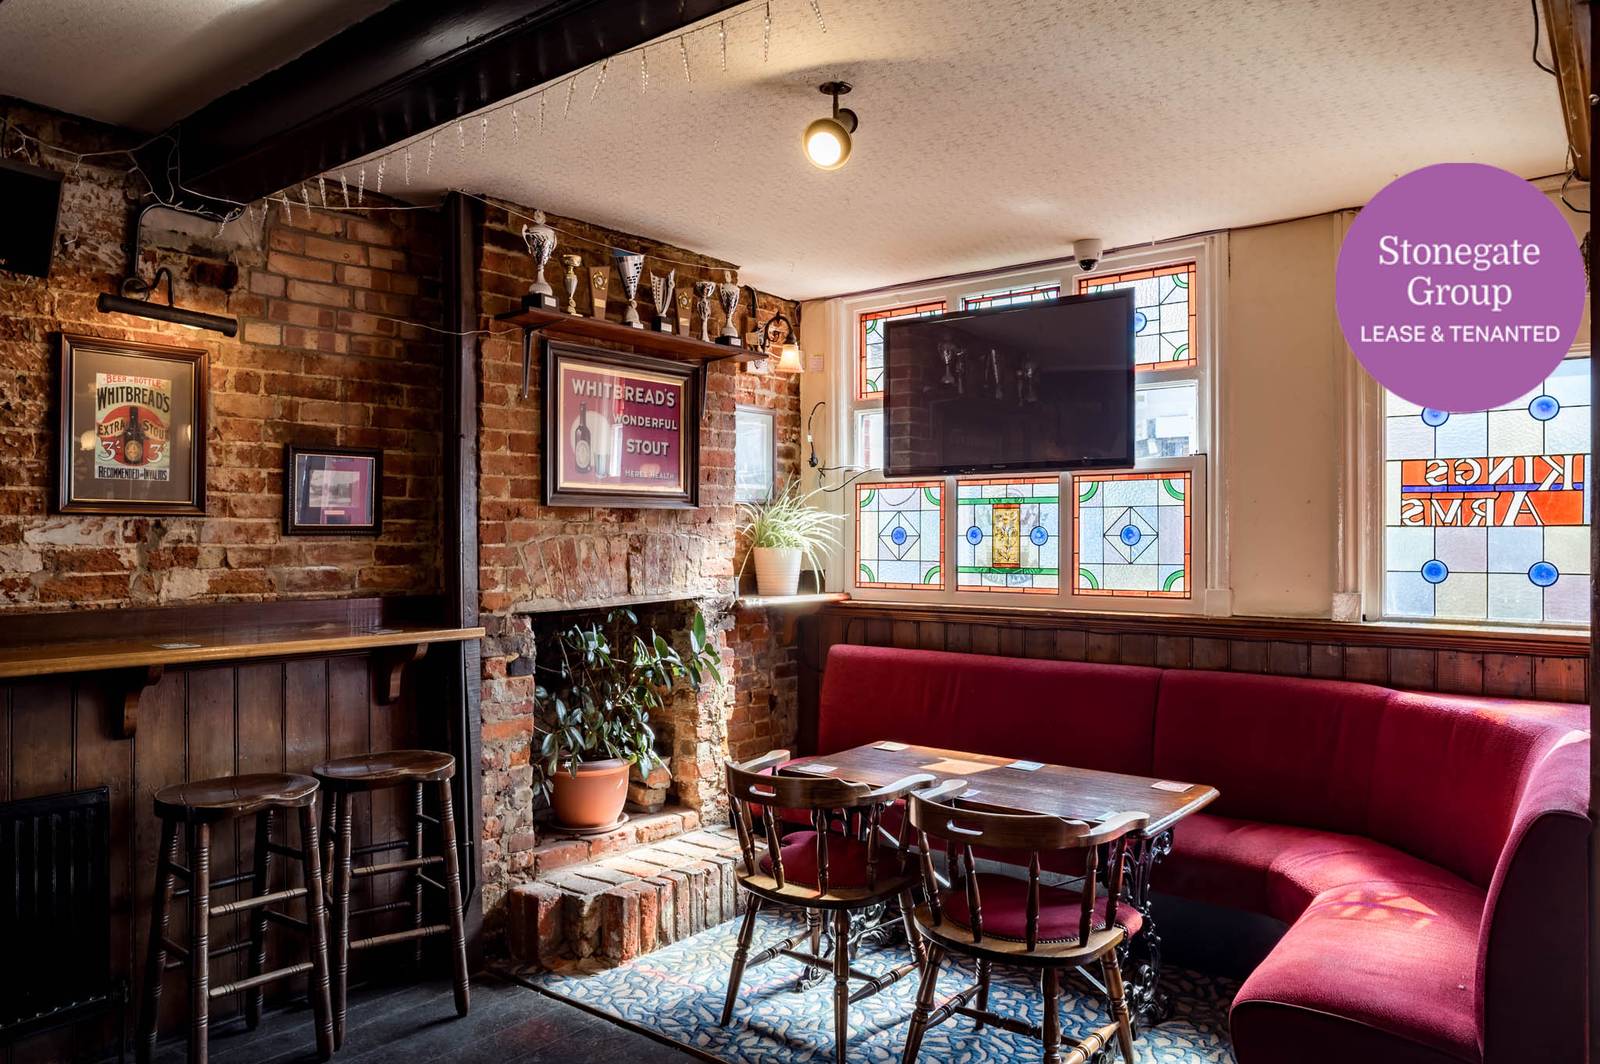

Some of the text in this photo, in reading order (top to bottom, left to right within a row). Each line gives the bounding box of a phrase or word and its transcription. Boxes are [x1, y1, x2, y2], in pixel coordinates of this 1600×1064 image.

[97, 386, 170, 413] WHITBREAD'S
[572, 378, 676, 407] WHITBREAD'S
[98, 419, 126, 436] EXTRA
[613, 414, 678, 431] WONDERFUL
[626, 439, 670, 457] STOUT
